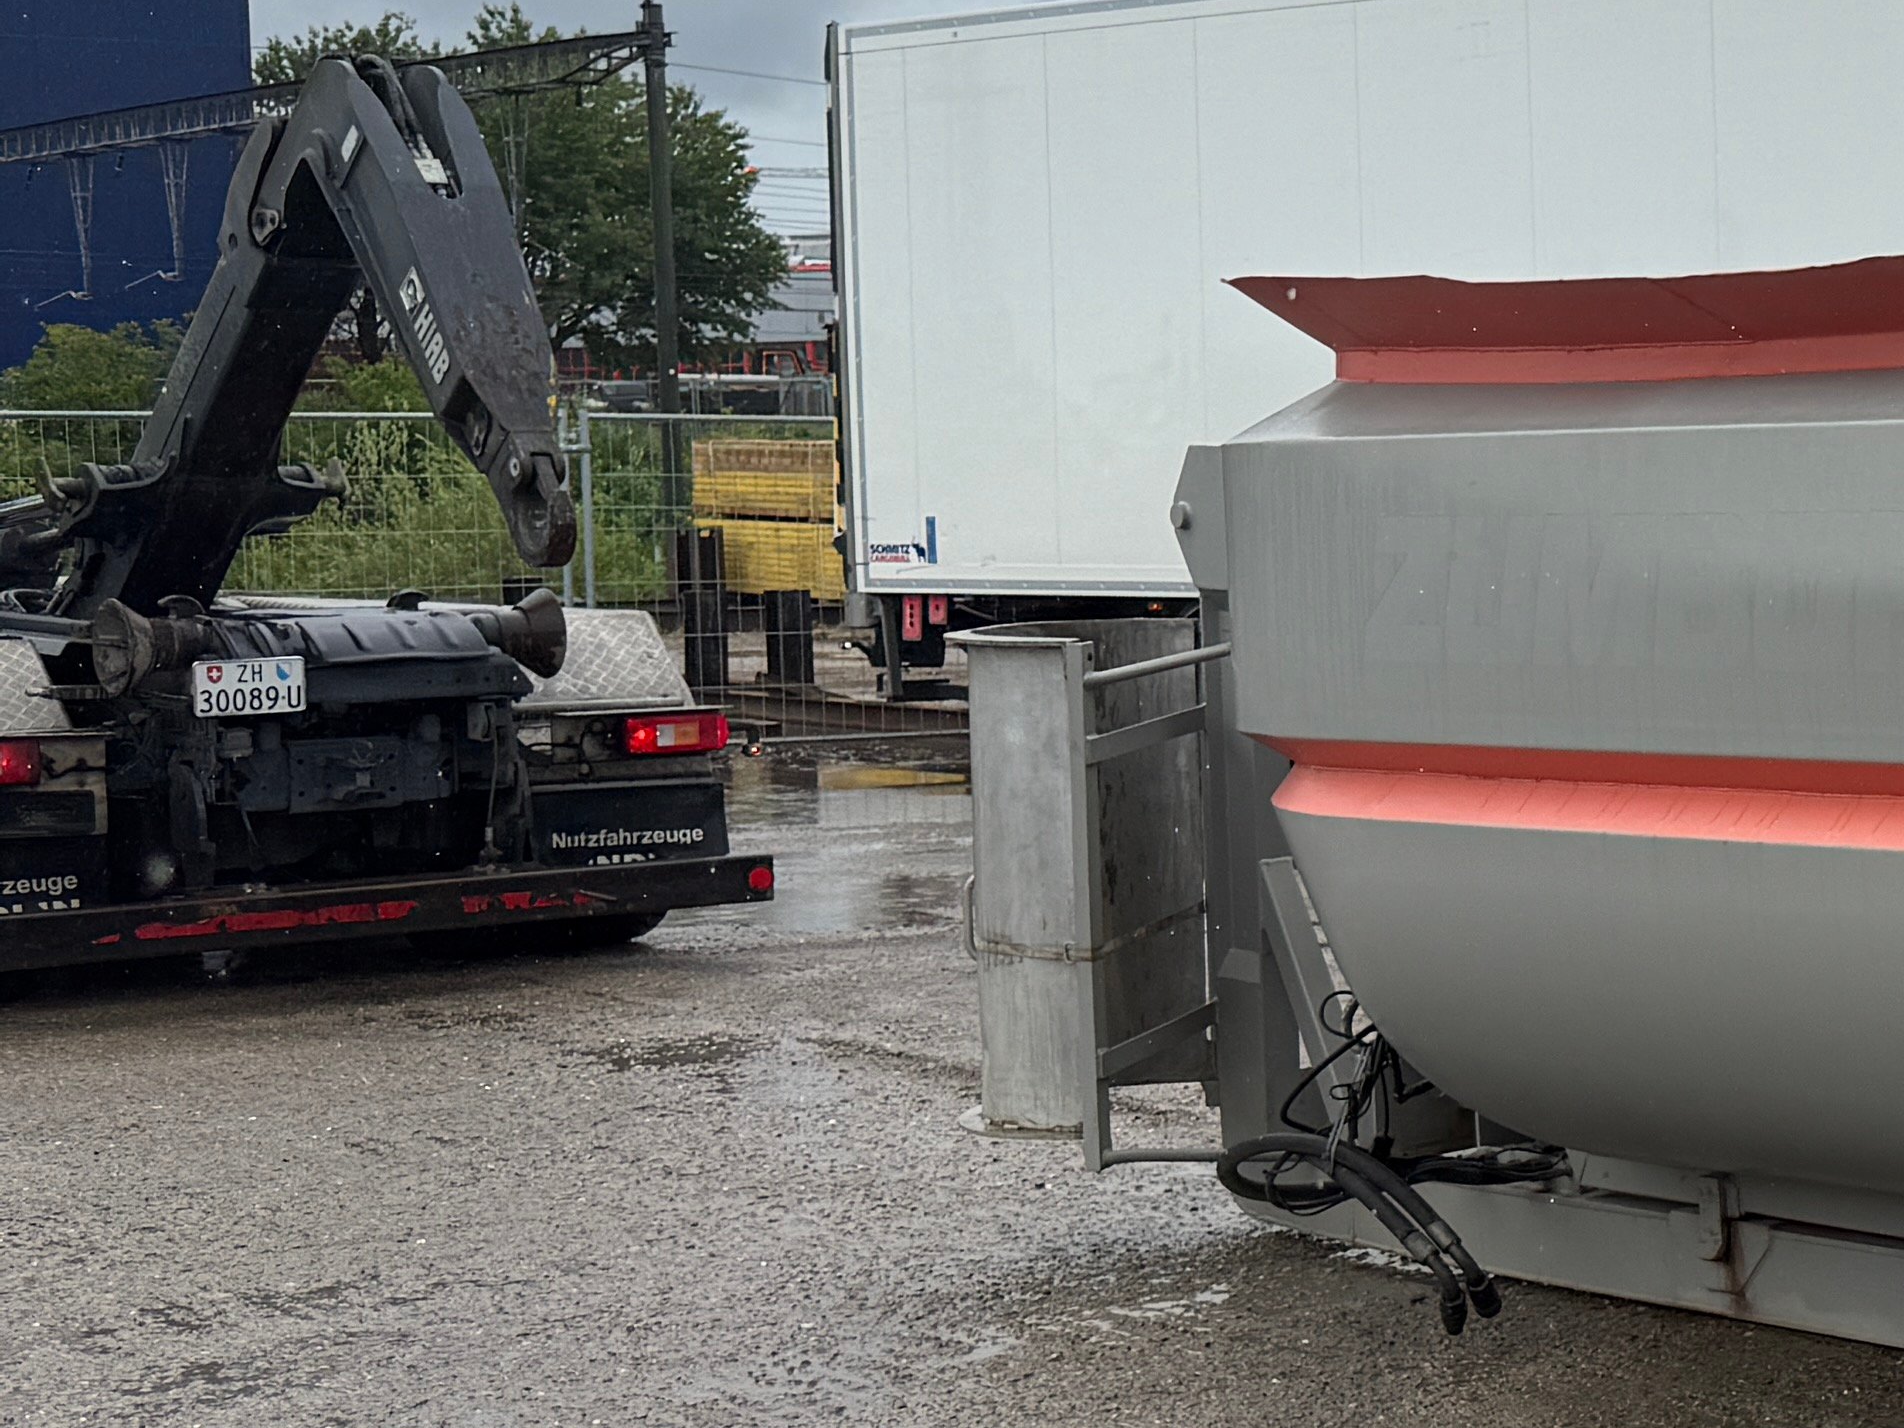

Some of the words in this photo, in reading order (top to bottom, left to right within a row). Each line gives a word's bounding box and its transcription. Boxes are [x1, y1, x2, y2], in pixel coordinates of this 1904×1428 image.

[413, 303, 450, 384] HIAB
[237, 664, 263, 683] ZH
[552, 828, 704, 849] Nutzfahrzeuge
[0, 875, 79, 896] zeuge
